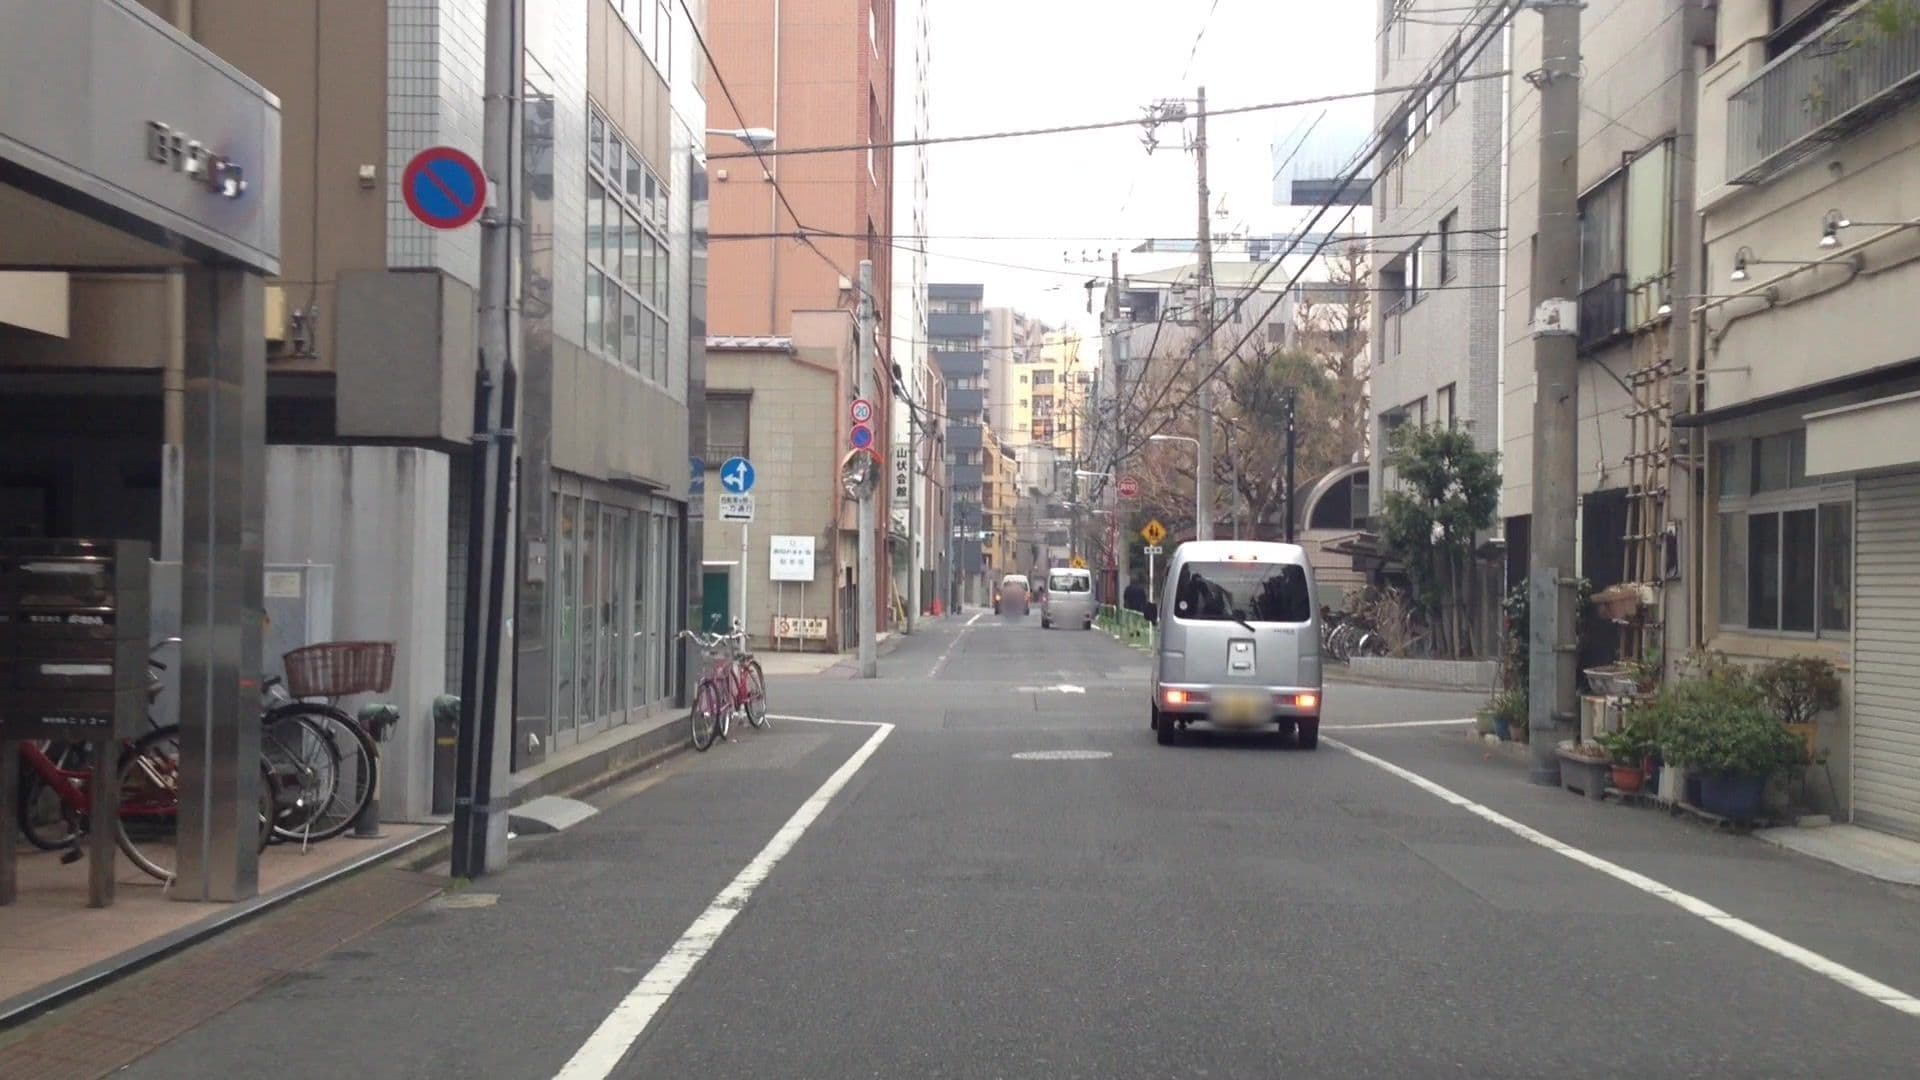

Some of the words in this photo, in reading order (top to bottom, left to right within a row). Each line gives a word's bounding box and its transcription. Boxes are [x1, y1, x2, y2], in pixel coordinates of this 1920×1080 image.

[856, 405, 868, 417] 20
[896, 447, 907, 497] 山伏会館
